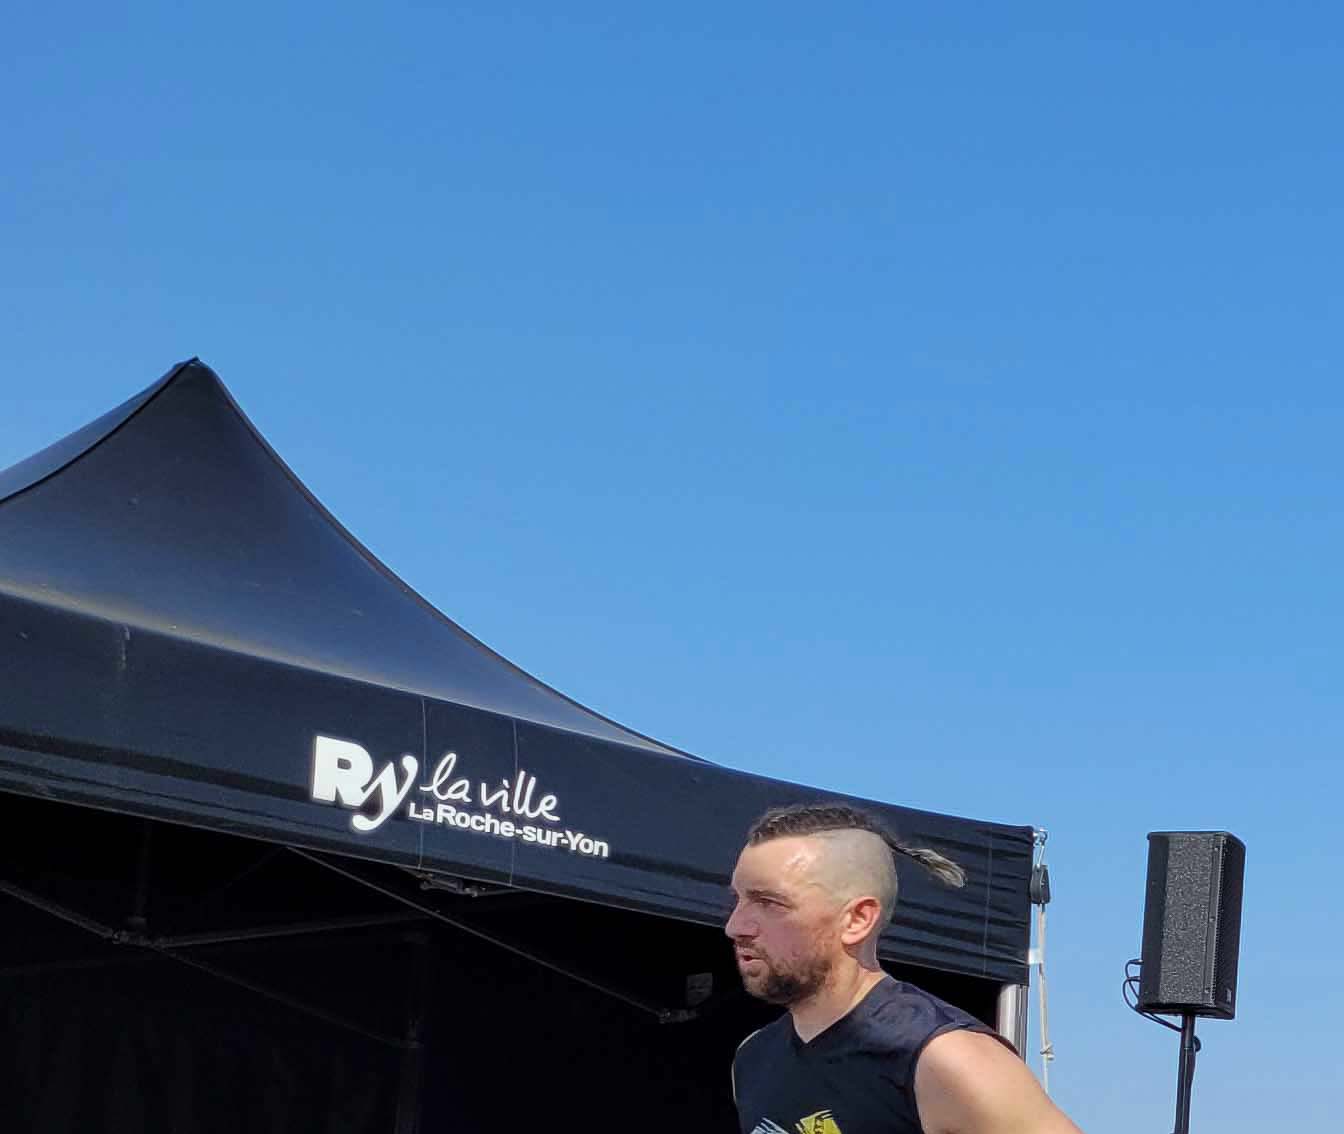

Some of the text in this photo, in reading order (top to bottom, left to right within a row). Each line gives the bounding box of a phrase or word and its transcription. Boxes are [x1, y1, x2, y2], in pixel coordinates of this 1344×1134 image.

[312, 735, 418, 831] Ry
[420, 753, 560, 821] la ville
[409, 803, 609, 857] La Roche-sur-Yon
